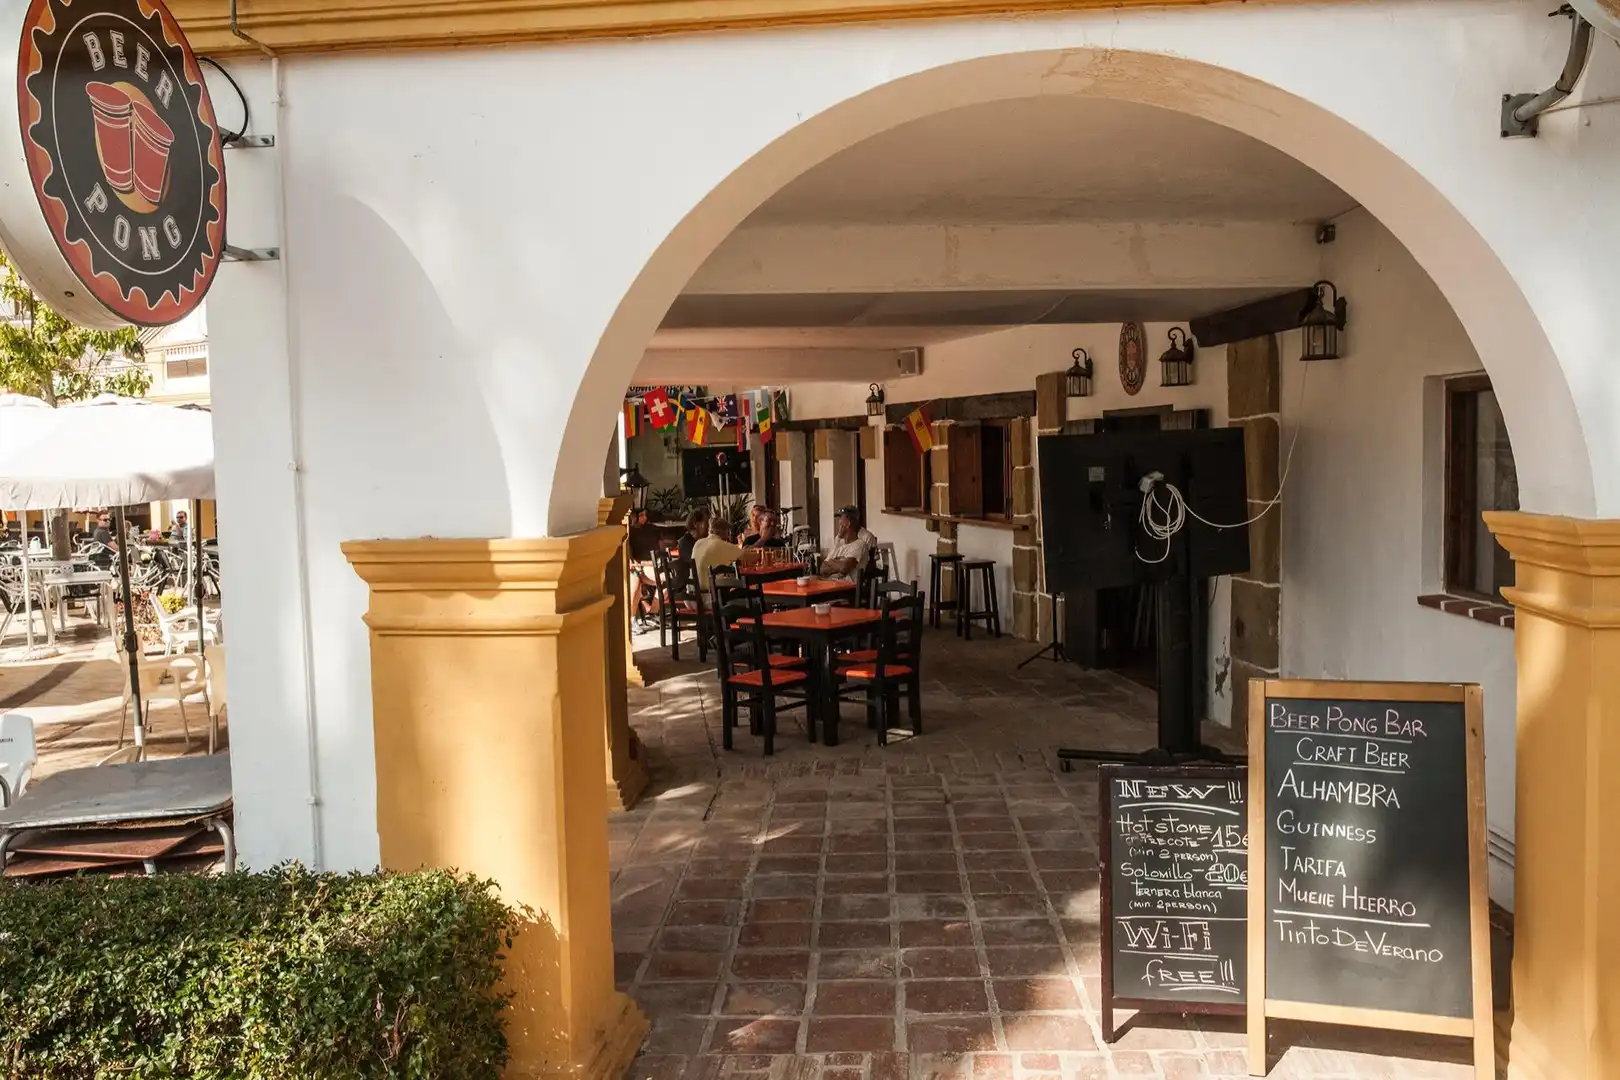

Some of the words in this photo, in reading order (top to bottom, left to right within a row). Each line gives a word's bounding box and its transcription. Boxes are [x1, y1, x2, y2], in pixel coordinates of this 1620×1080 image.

[82, 30, 173, 109] BEER
[84, 182, 183, 260] PONG
[1270, 703, 1320, 729] BEER
[1326, 706, 1377, 733] PONG
[1385, 709, 1427, 737] BAR
[1296, 737, 1357, 763] CRAFT
[1365, 741, 1411, 768] BEER
[1277, 769, 1401, 809] ALHAMBRA
[1116, 813, 1154, 833] Hot
[1276, 809, 1377, 844] GUINNESS
[1280, 846, 1347, 877] TARIFA
[1183, 883, 1222, 899] blanca
[1342, 884, 1417, 917] HIERRO
[1118, 920, 1212, 950] Wi-Fi
[1273, 919, 1329, 945] Tinto
